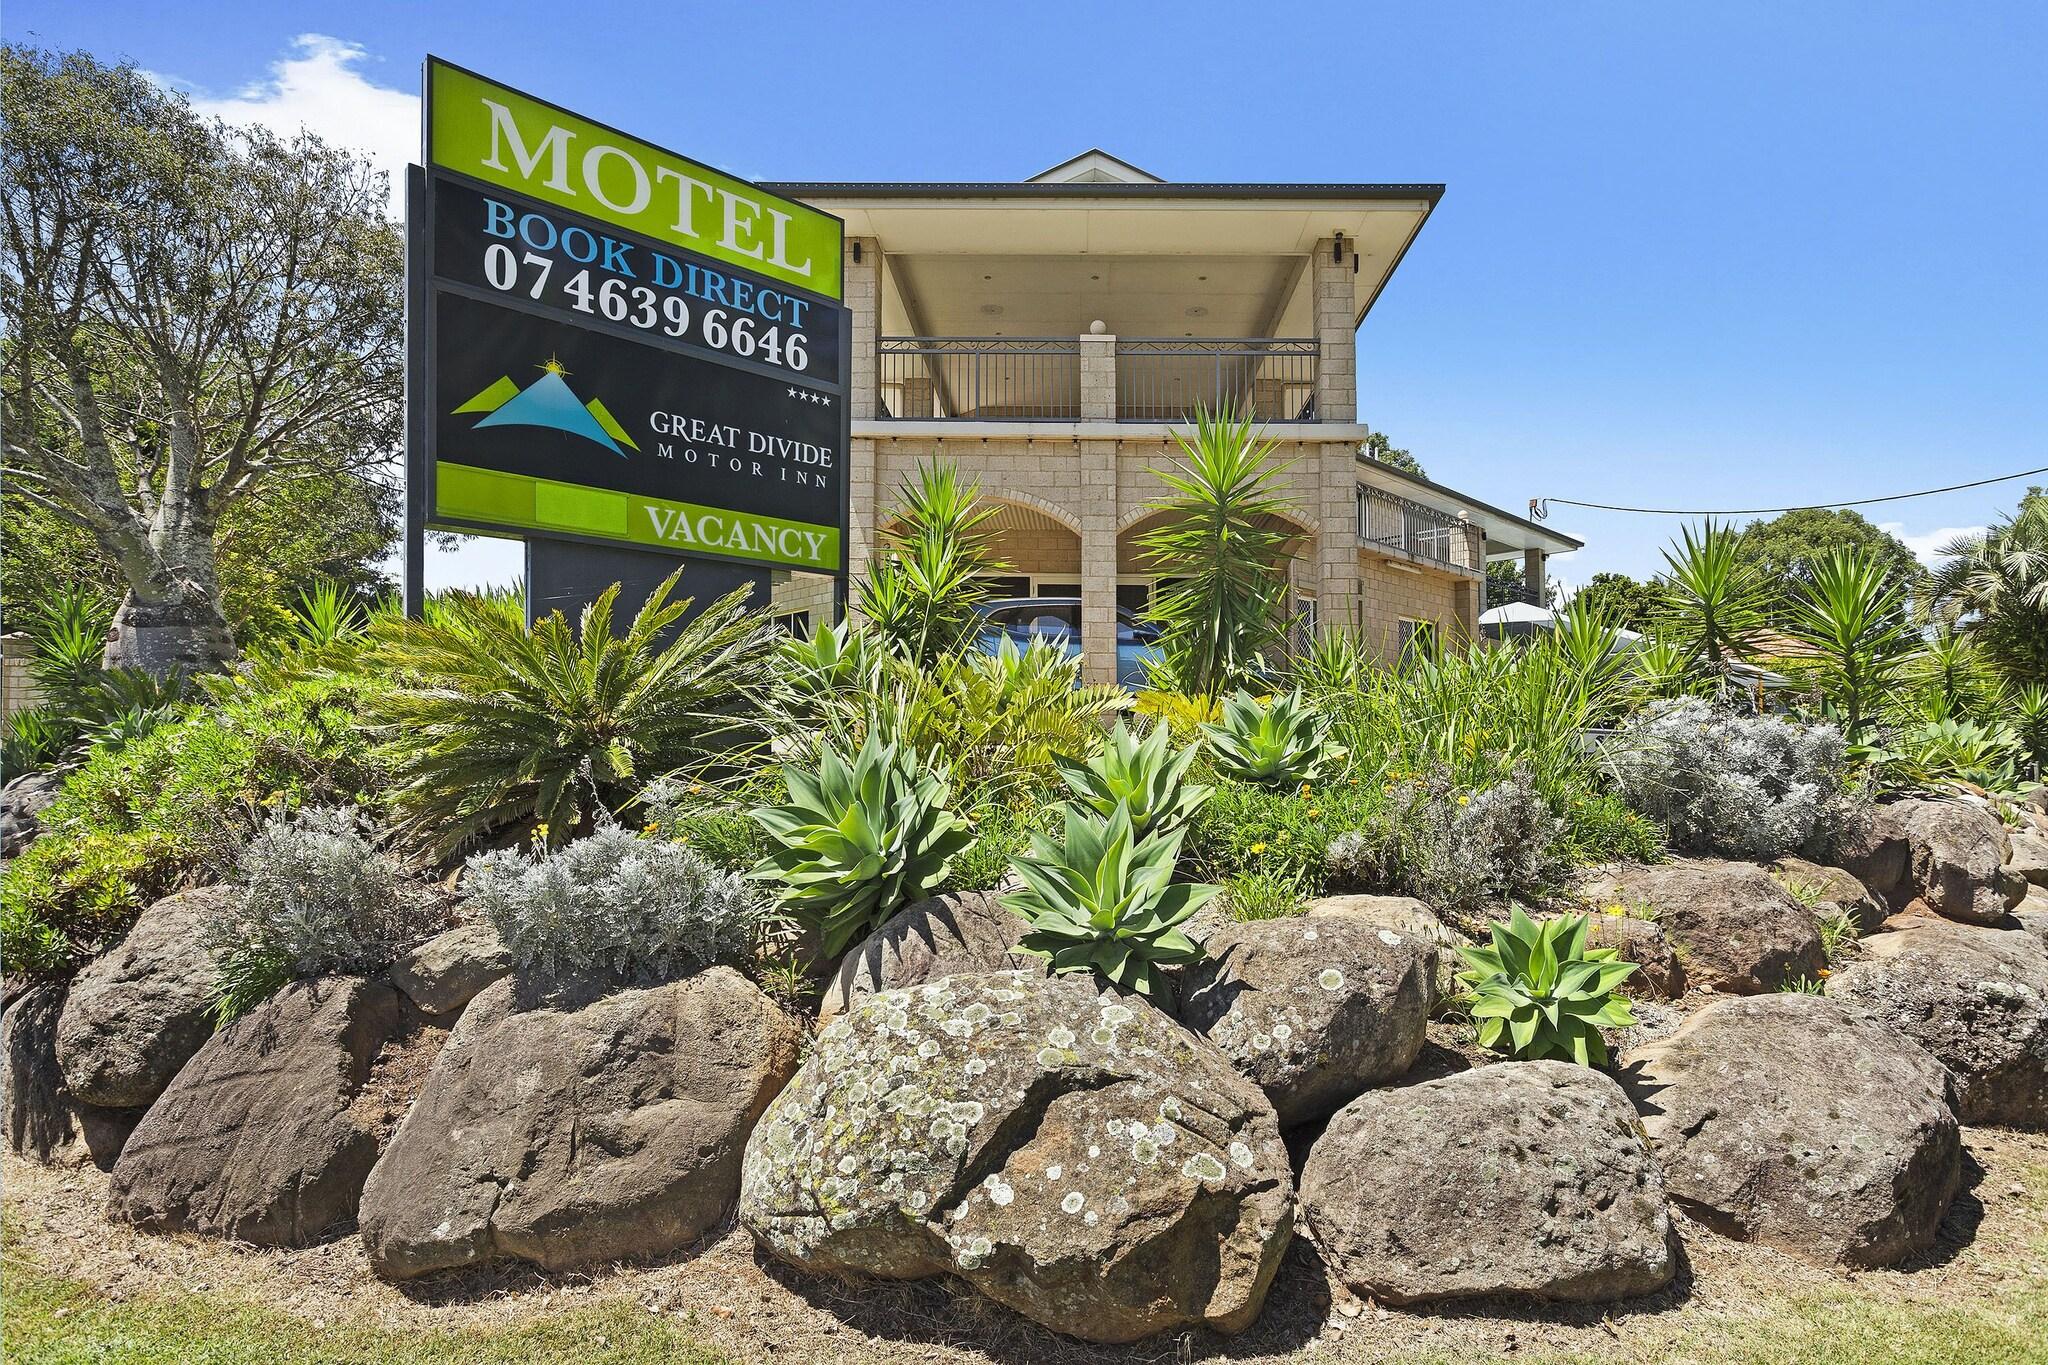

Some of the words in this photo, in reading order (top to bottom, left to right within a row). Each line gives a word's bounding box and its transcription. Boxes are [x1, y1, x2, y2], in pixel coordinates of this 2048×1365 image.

[481, 98, 811, 276] MOTEL
[483, 198, 636, 278] BOOK
[652, 252, 808, 328] DIRECT
[484, 244, 553, 299] 07
[564, 269, 690, 336] 4639
[703, 309, 808, 371] 6646
[650, 411, 741, 448] GREAT
[748, 432, 832, 467] DIVIDE
[657, 442, 763, 476] MOTOR
[781, 467, 827, 488] INN
[644, 505, 827, 560] VACANCY
